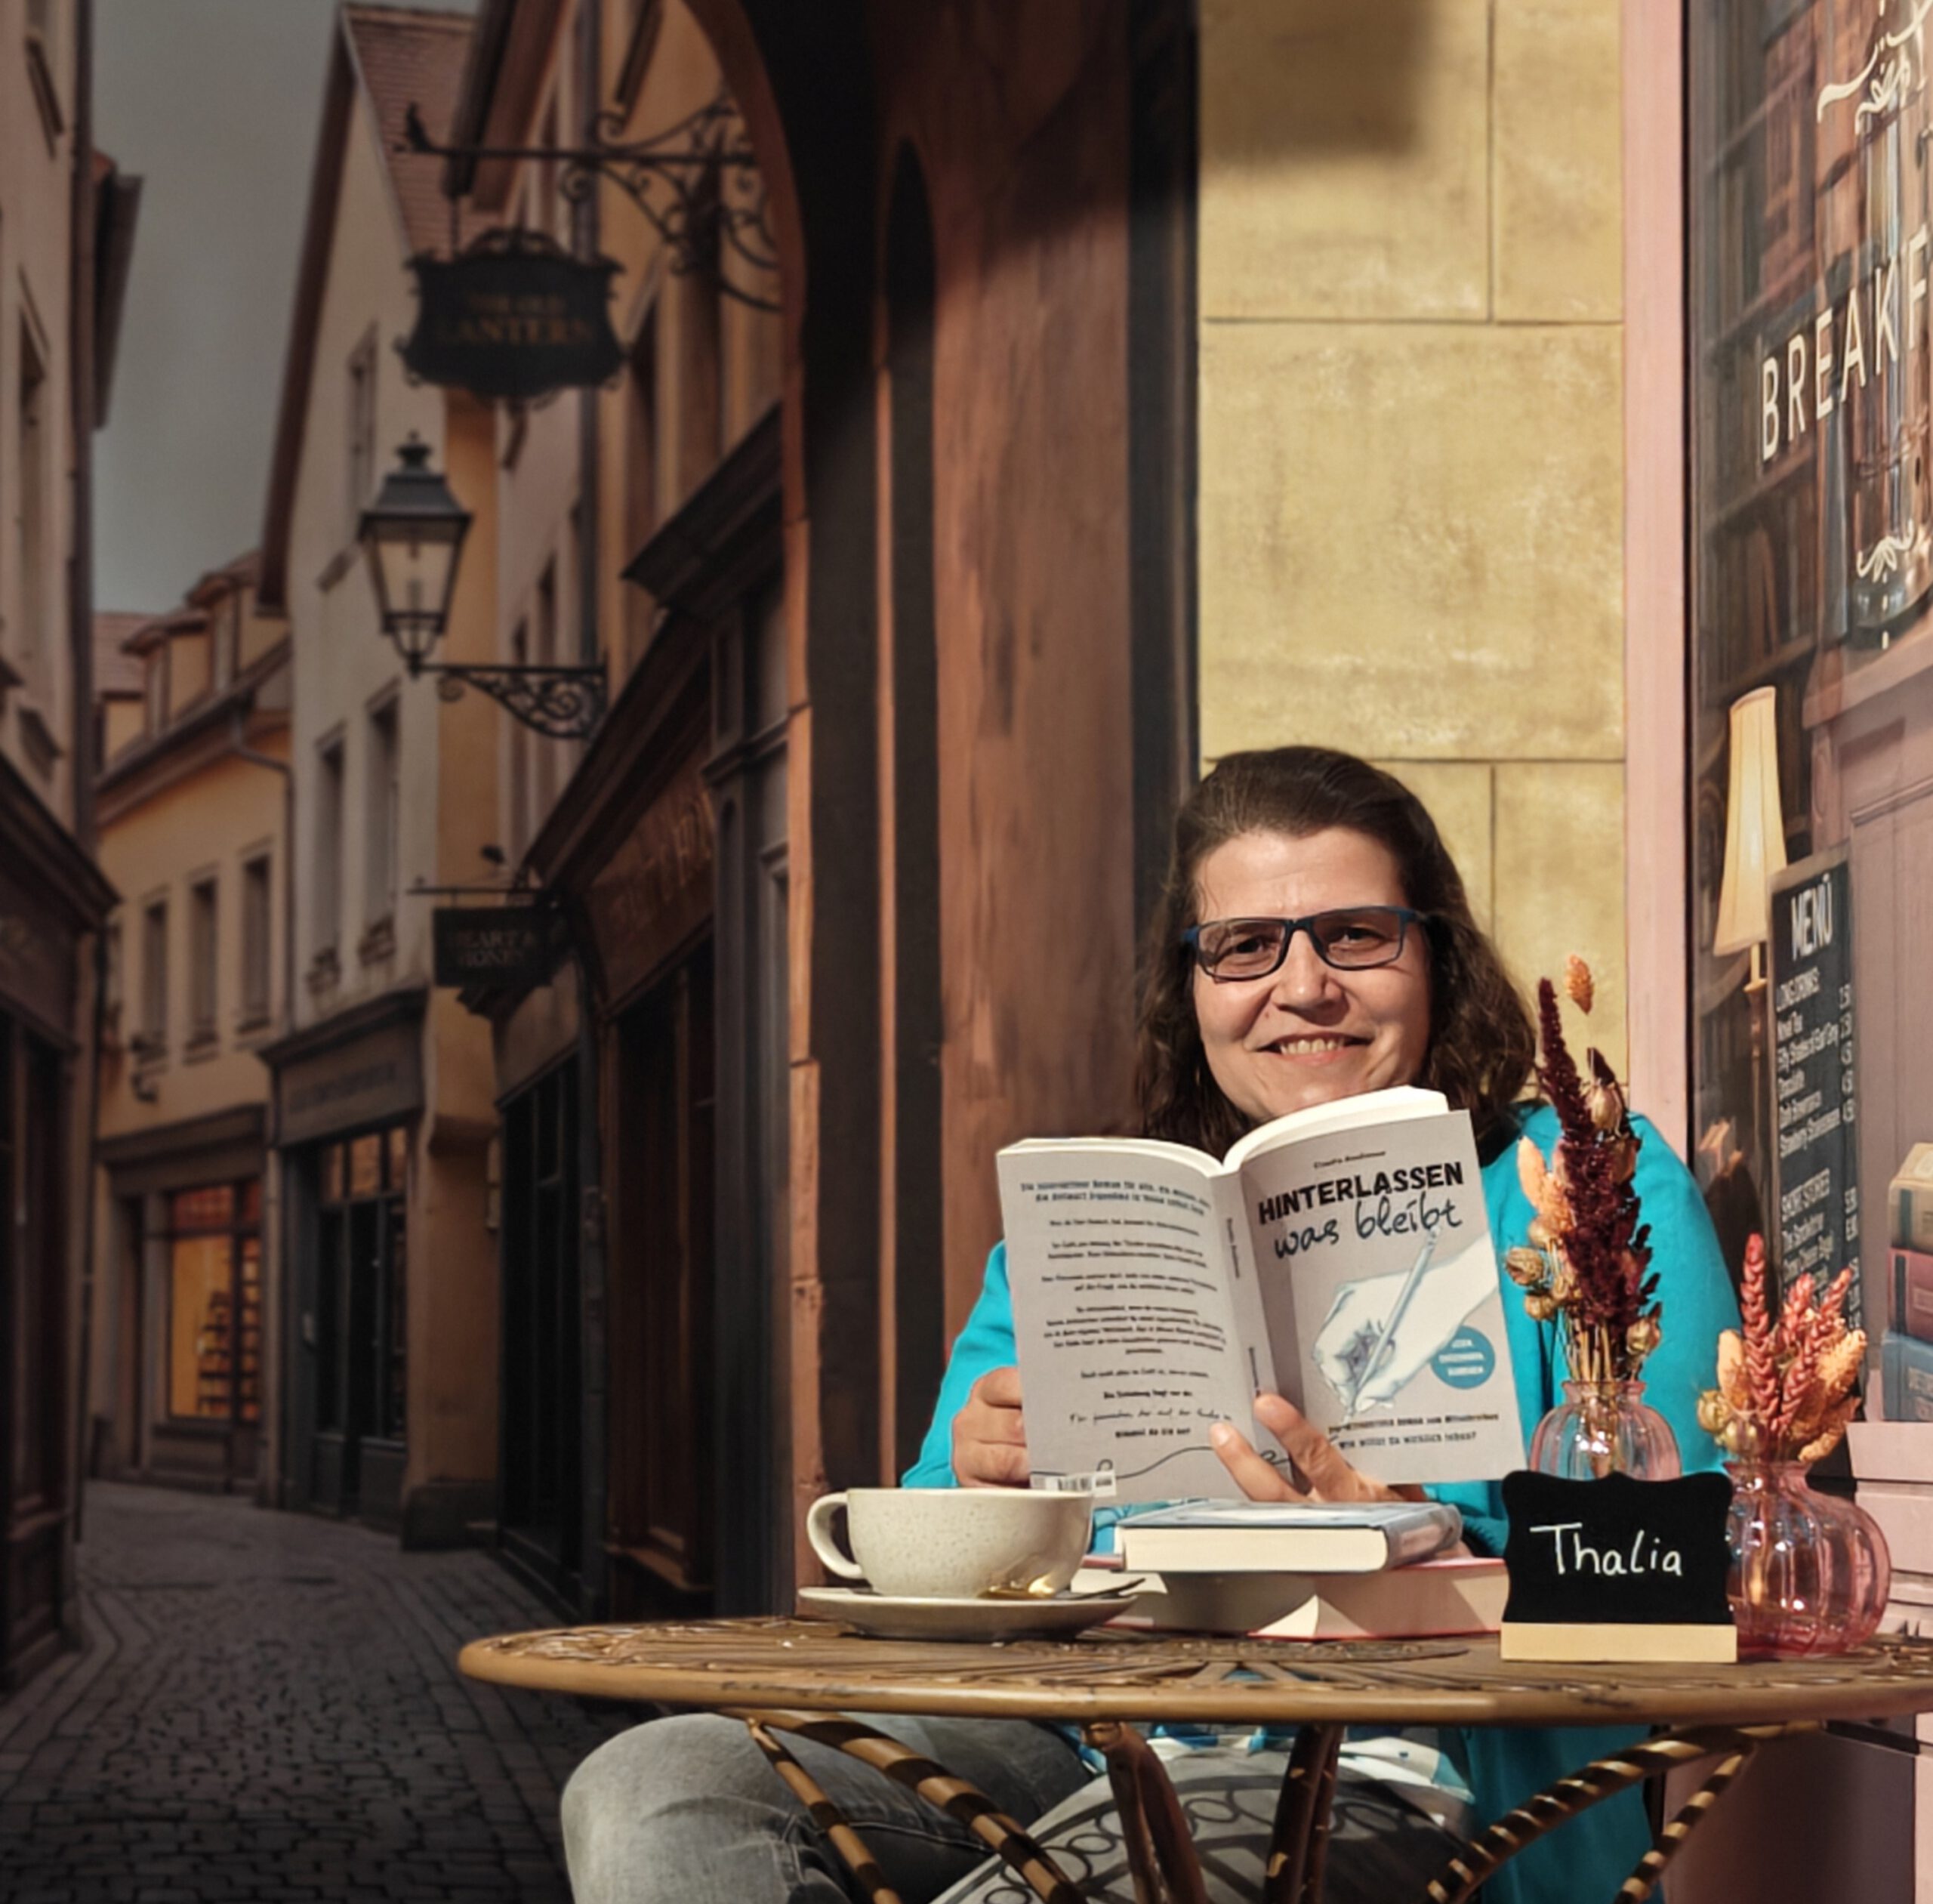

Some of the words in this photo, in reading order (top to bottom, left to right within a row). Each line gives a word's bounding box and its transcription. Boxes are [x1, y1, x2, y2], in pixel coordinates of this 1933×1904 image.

[1762, 224, 1928, 461] BREAKF
[1257, 1161, 1464, 1226] HINTERLASSEN
[1274, 1218, 1340, 1260] was
[1355, 1190, 1463, 1239] bleibt
[1529, 1521, 1682, 1576] Thalia
